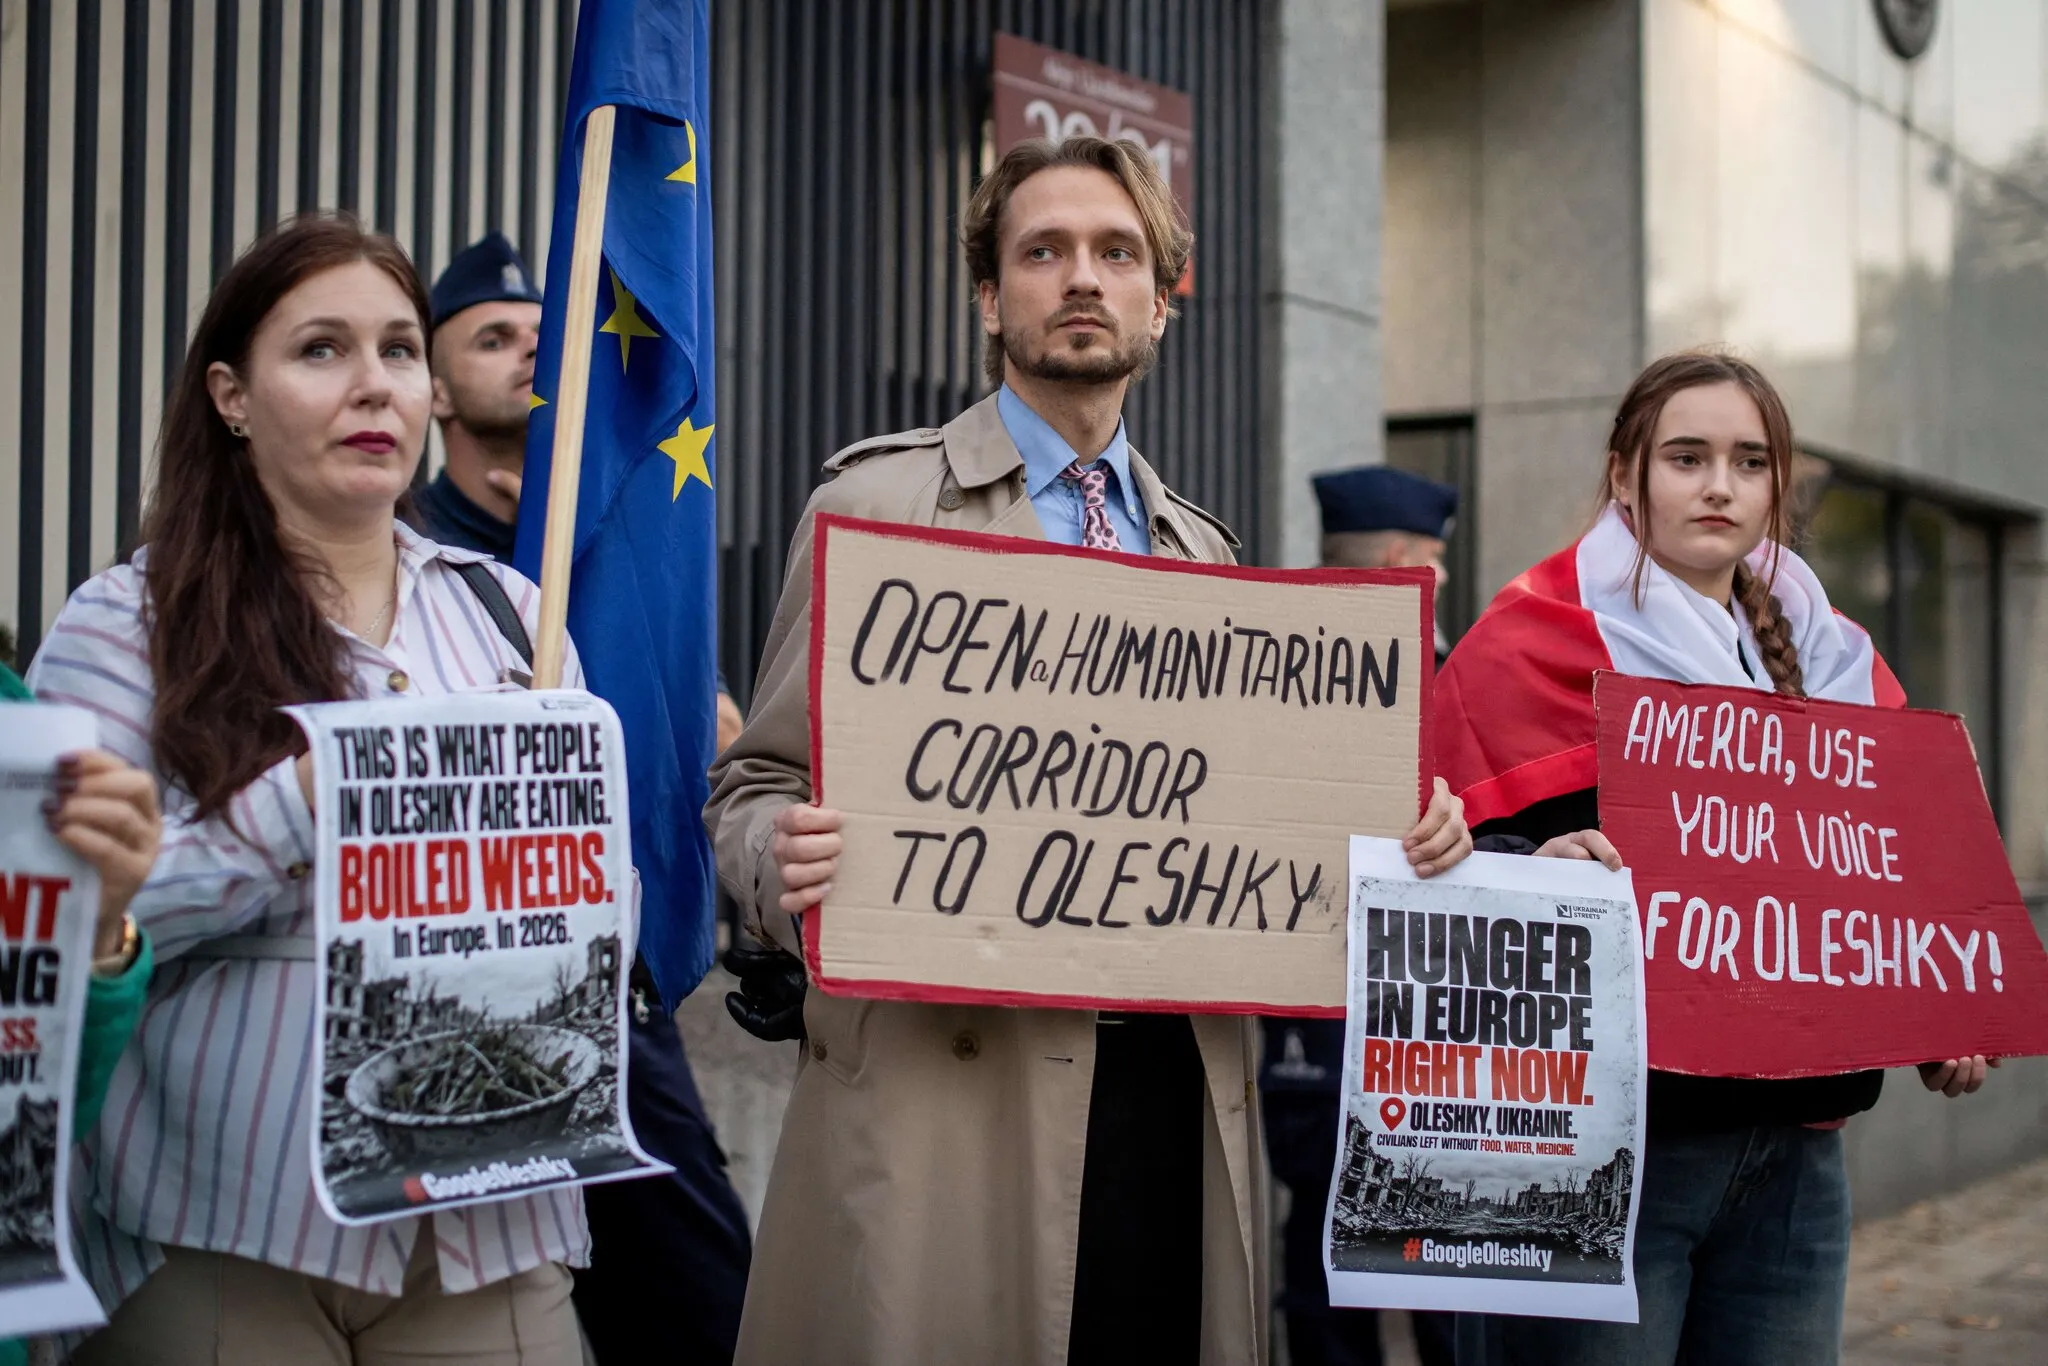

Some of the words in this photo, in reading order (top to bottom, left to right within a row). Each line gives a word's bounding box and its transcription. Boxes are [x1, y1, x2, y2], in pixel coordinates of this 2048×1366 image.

[851, 578, 1048, 693] OPEN
[1030, 659, 1048, 682] a
[333, 725, 396, 780] THIS
[405, 726, 428, 778] IS
[435, 723, 506, 777] WHAT
[516, 722, 603, 775] PEOPLE
[1624, 695, 1795, 785] AMERCA,
[1808, 722, 1877, 789] USE
[339, 786, 362, 838] IN
[371, 782, 471, 835] OLESHKY
[479, 781, 520, 831] ARE
[527, 778, 612, 828] EATING.
[1672, 791, 1779, 864] YOUR
[340, 839, 470, 923] BOILED
[480, 831, 613, 911] WEEDS.
[893, 826, 986, 916] TO
[1016, 830, 1322, 932] OLESHKY
[1573, 906, 1607, 915] UKRAINIAN
[394, 925, 411, 958] In
[419, 919, 492, 959] Europe.
[497, 917, 515, 949] In
[520, 913, 572, 947] 2026.
[1367, 907, 1592, 995] HUNGER
[1645, 891, 1740, 980] FOR
[1754, 896, 2003, 993] OLESHKY!
[1366, 980, 1414, 1039] IN
[1424, 985, 1594, 1051] EUROPE
[1363, 1038, 1482, 1099] RIGHT
[1491, 1046, 1594, 1106] NOW.
[1377, 1133, 1418, 1148] CIVILIANS
[1420, 1137, 1437, 1149] LEFT
[1441, 1138, 1478, 1151] WITHOUT
[1480, 1139, 1503, 1154] FOOD,
[1505, 1141, 1534, 1155] WATER,
[1536, 1142, 1577, 1156] MEDICINE.
[1410, 1101, 1491, 1137] OLESHKY,
[1496, 1106, 1578, 1139] UKRAINE.
[1403, 1237, 1552, 1272] #GoogleOleshky
